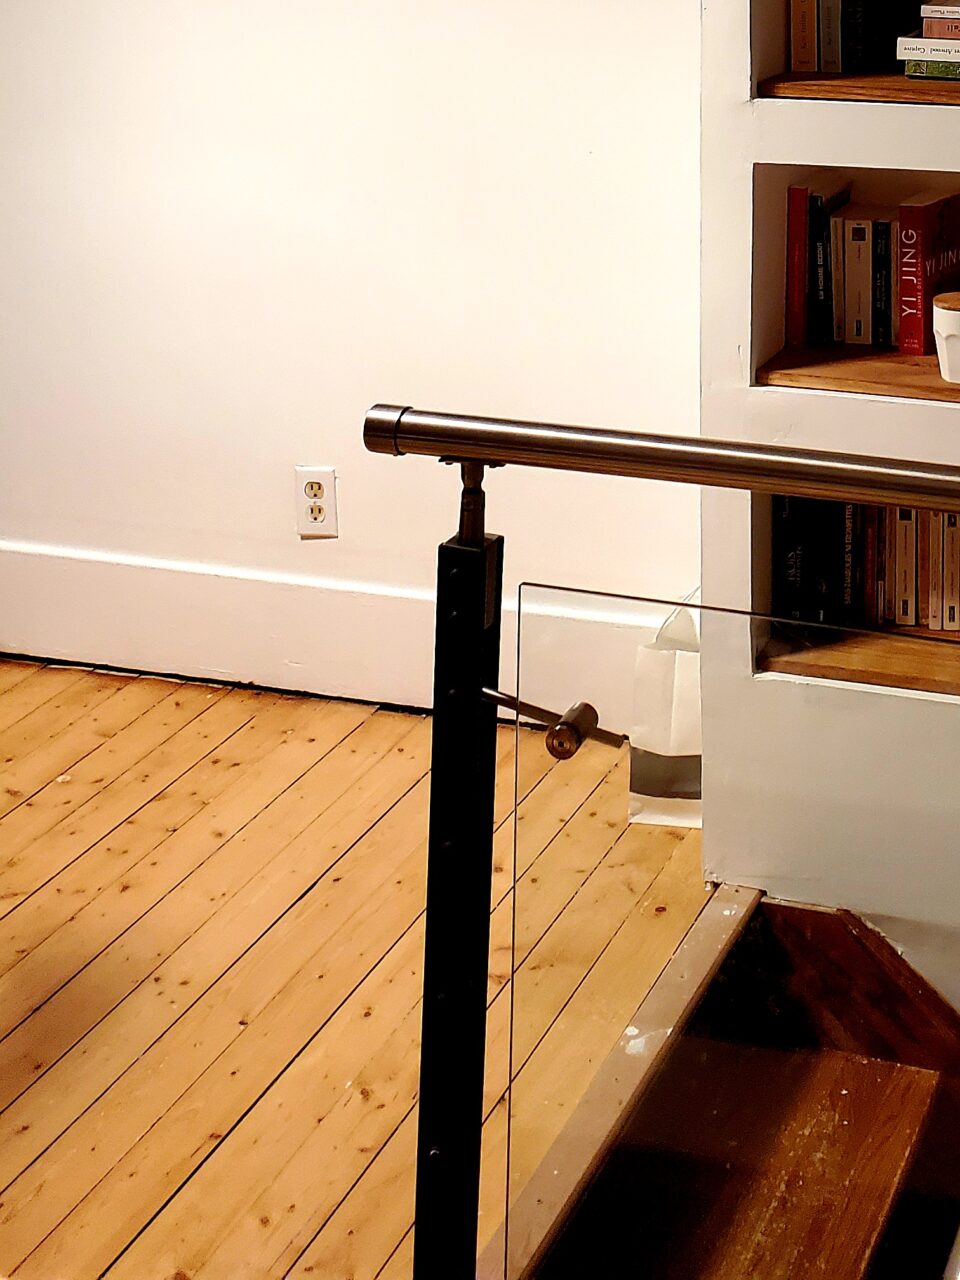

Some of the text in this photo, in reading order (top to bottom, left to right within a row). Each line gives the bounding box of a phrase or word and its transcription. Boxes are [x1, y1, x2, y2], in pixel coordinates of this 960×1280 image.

[903, 45, 926, 54] Captive
[902, 229, 917, 317] YI JING
[925, 257, 935, 277] YI
